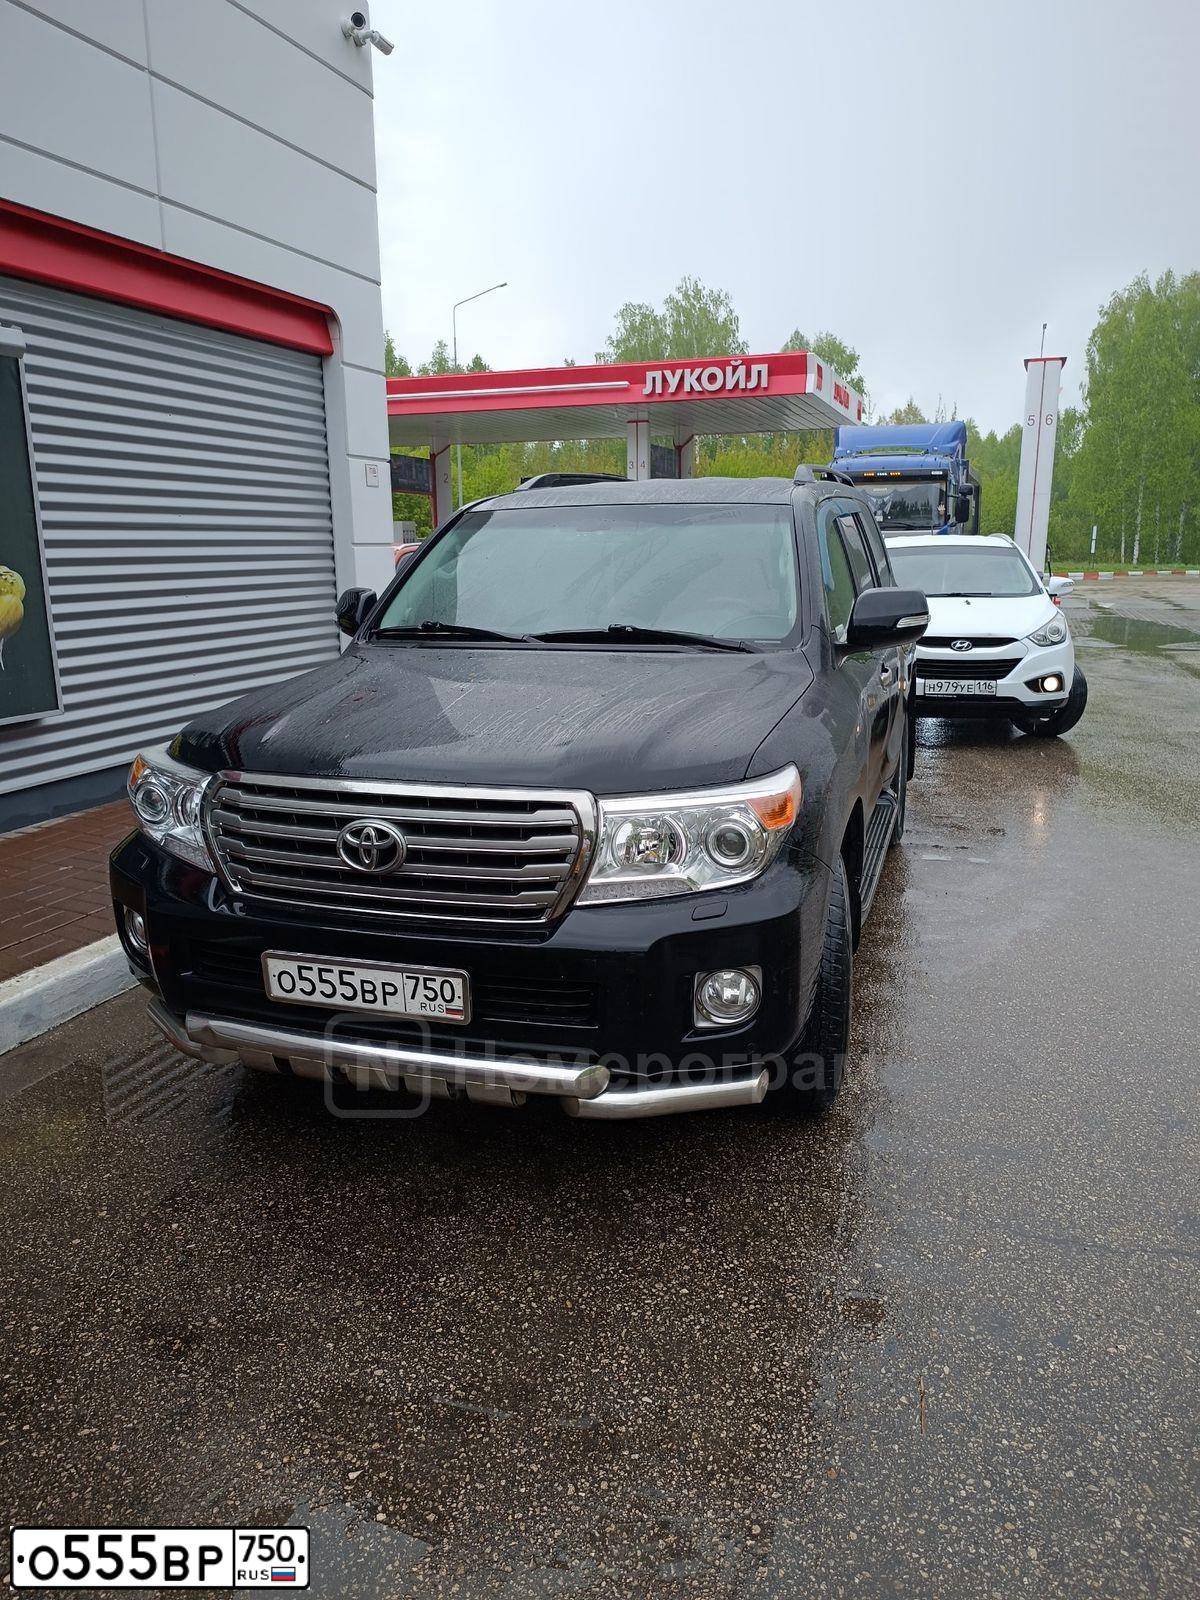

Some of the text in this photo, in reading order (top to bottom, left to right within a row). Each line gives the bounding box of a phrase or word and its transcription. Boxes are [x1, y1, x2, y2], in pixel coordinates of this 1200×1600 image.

[642, 360, 769, 395] ЛУКОЙЛ
[1027, 413, 1053, 427] 5 6
[628, 460, 646, 470] 3 4
[443, 473, 449, 483] 2
[928, 681, 974, 693] Н979УЕ
[976, 681, 993, 690] 116
[277, 965, 456, 1006] О555ВР 750
[420, 1002, 445, 1014] RUS
